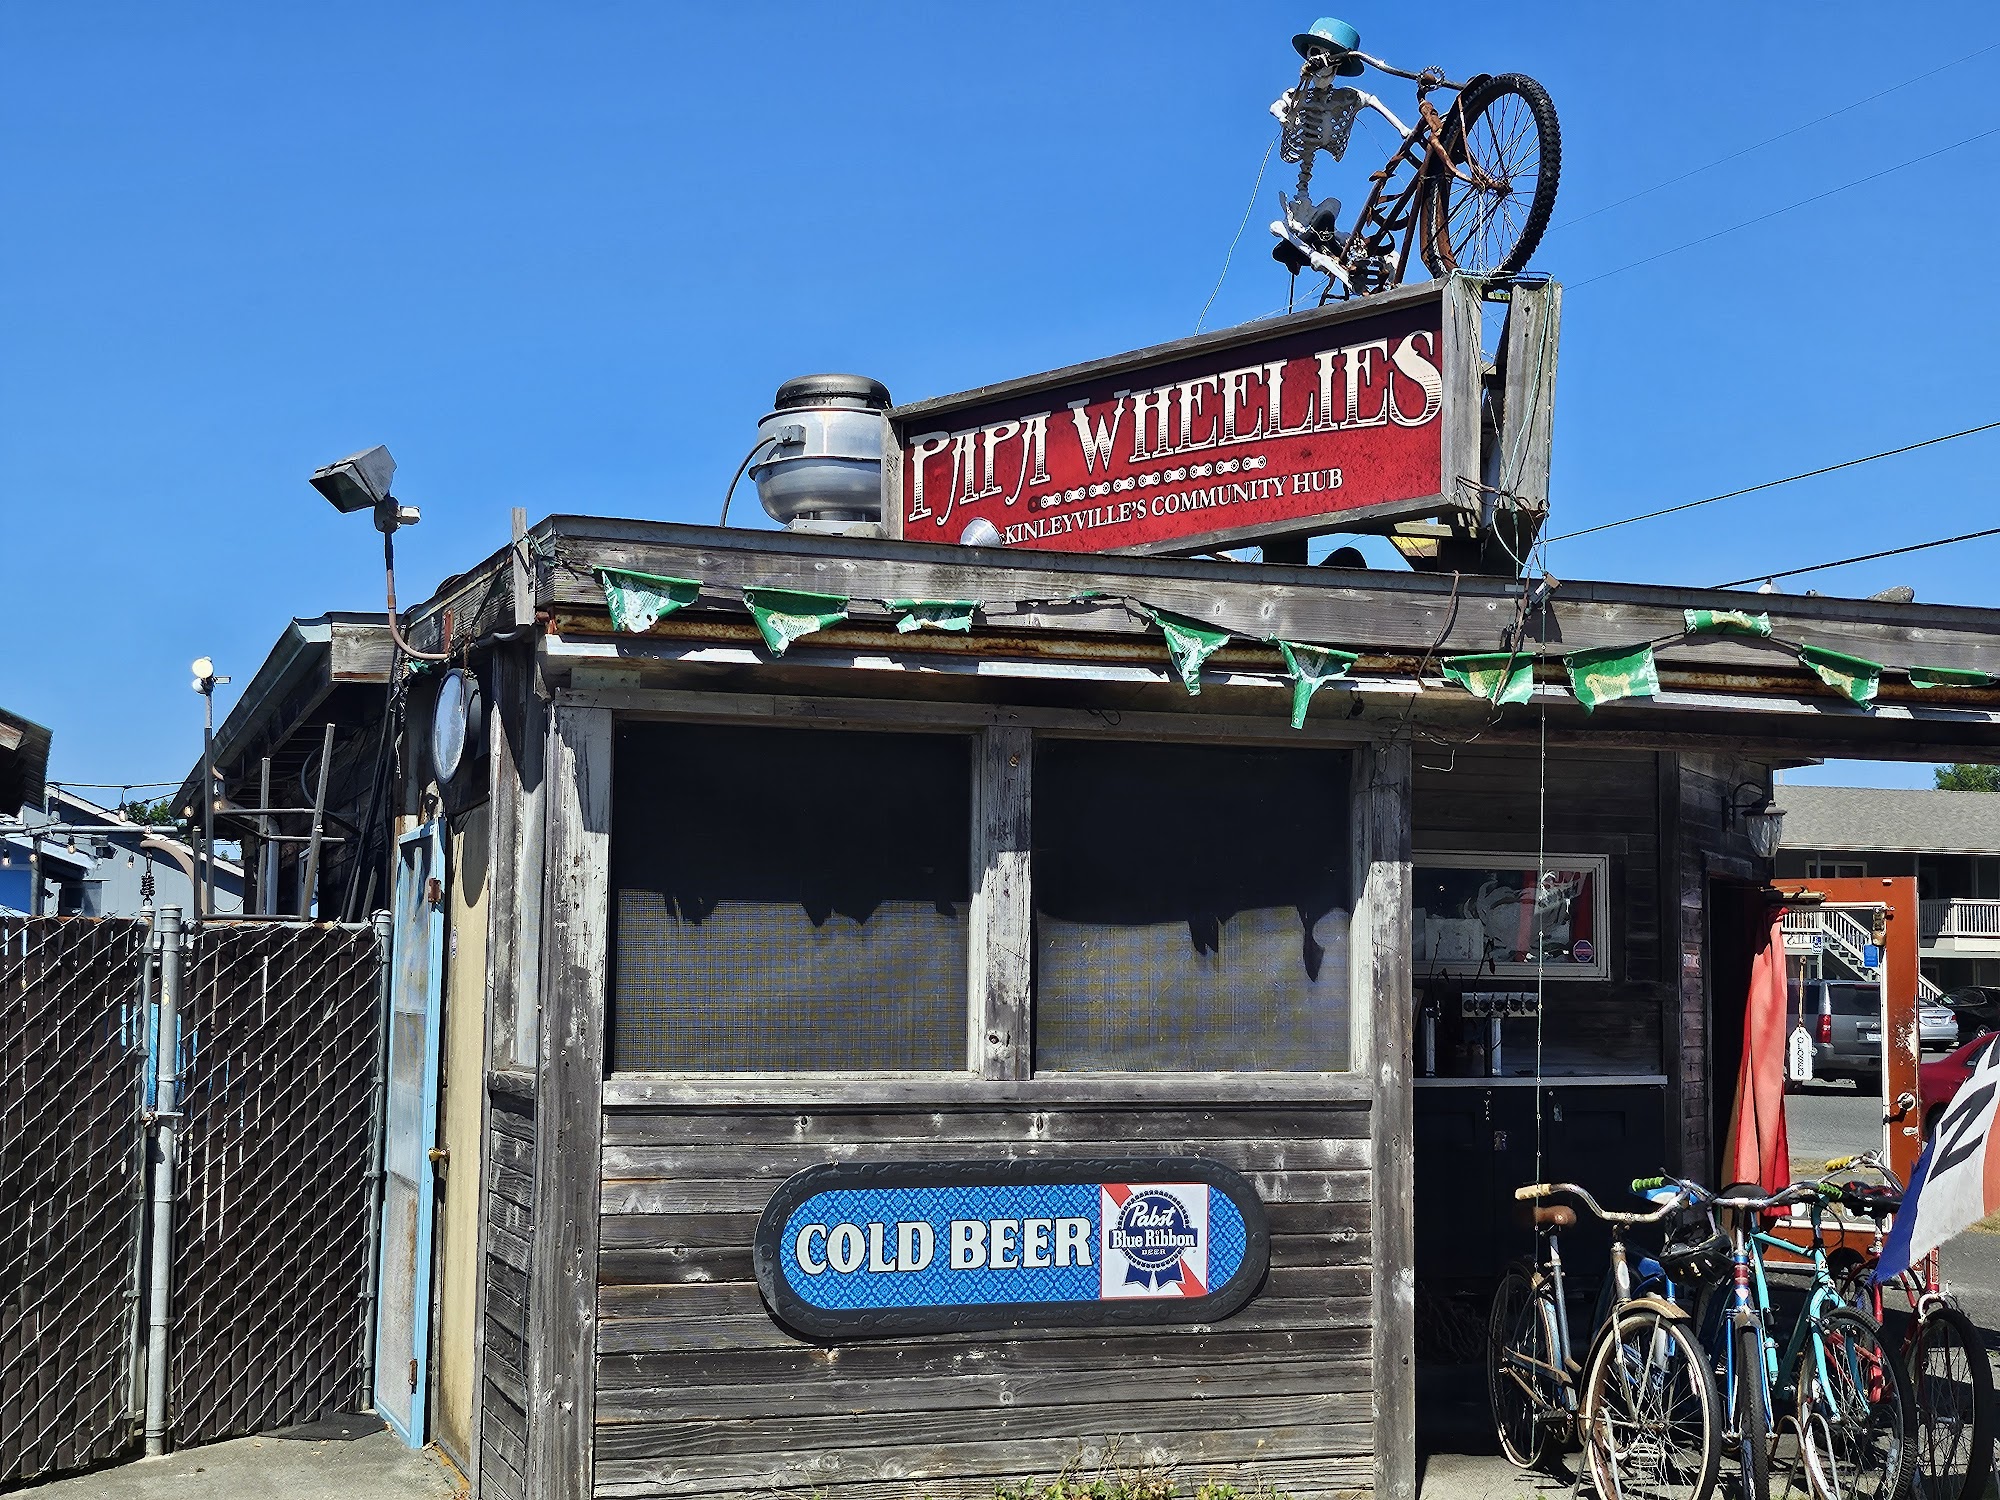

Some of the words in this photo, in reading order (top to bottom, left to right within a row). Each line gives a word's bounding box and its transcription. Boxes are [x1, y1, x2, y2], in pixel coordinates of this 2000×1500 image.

[908, 410, 1052, 526] PAPA
[1067, 330, 1443, 475] WHEELIES
[1151, 476, 1288, 517] COMMUNITY
[1292, 468, 1344, 495] HUB
[1128, 1200, 1176, 1227] Pabst
[797, 1222, 936, 1275] COLD
[950, 1217, 1094, 1270] BEER
[1111, 1229, 1143, 1249] Blue
[1144, 1228, 1196, 1248] Ribbon
[1141, 1248, 1167, 1256] BEER
